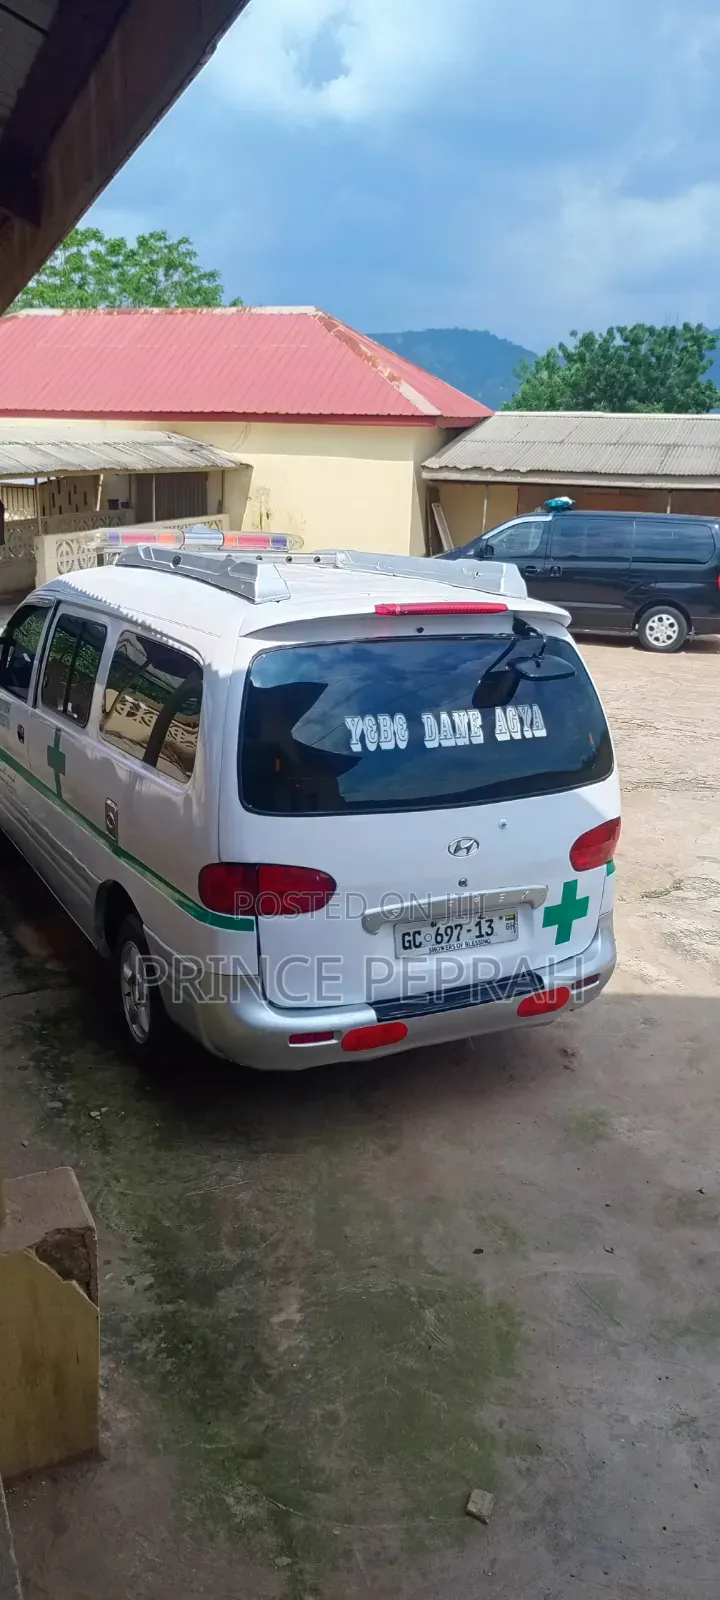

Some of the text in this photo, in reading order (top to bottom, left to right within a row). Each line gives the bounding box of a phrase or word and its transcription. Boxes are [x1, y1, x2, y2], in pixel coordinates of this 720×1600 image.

[421, 709, 485, 748] DANE
[494, 704, 547, 741] AGYA
[401, 930, 423, 951] GC
[434, 918, 494, 945] 697-13
[428, 944, 456, 954] SHOWERS
[465, 938, 491, 948] BLESSING
